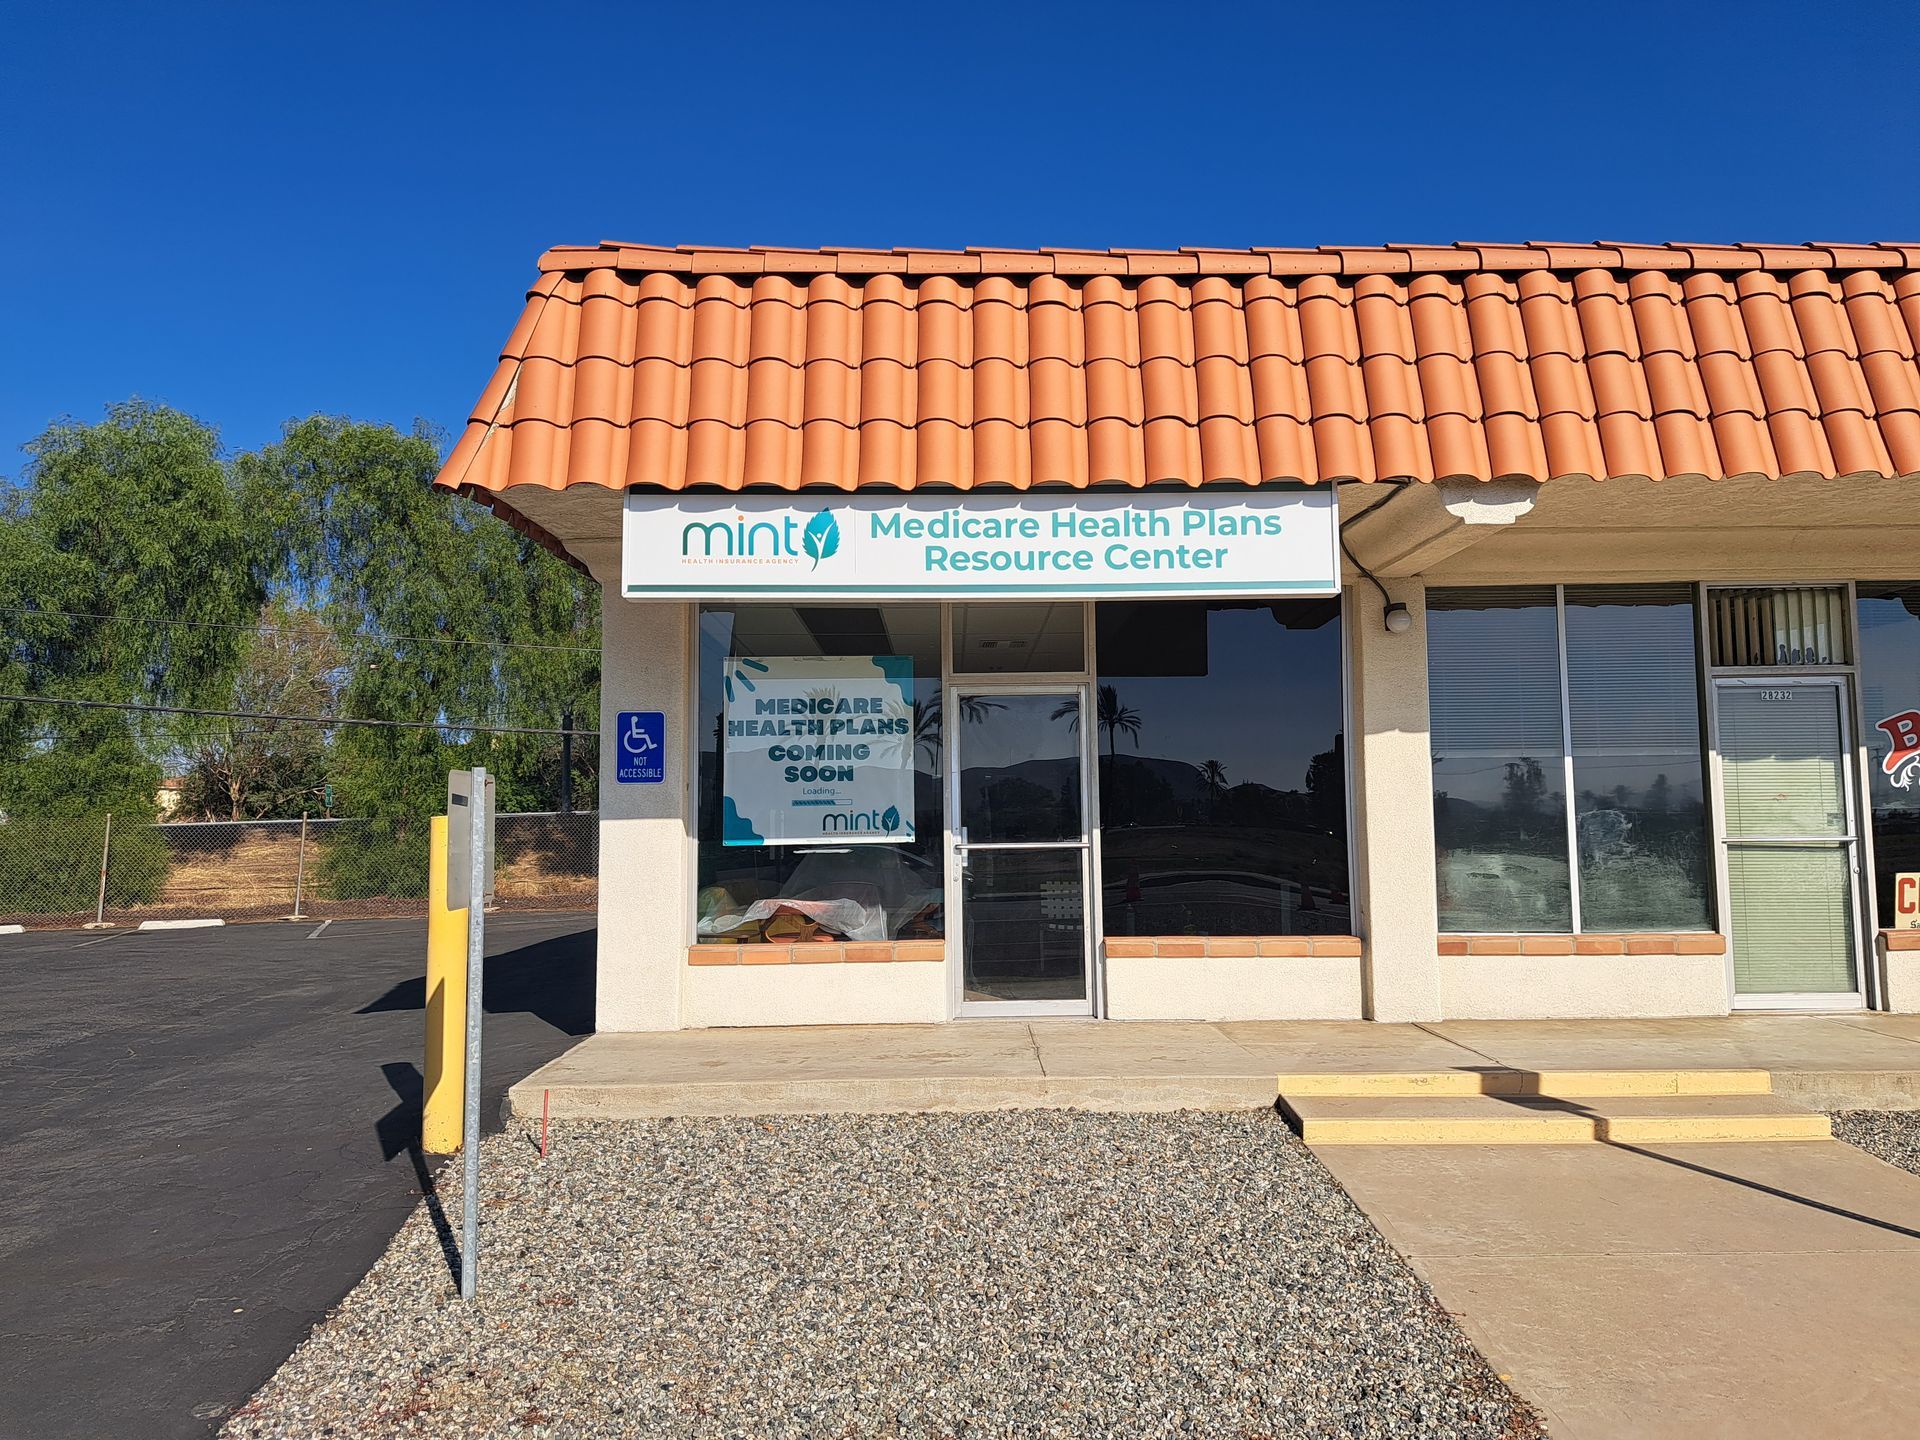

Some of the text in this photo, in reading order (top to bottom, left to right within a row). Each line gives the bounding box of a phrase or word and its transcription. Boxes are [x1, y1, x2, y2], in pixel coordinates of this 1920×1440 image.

[871, 508, 1282, 539] Medicare Health Plans
[682, 515, 798, 556] mint
[925, 543, 1228, 571] Resource Center
[1762, 691, 1792, 700] 28232
[755, 697, 883, 715] MEDICARE
[728, 718, 910, 737] HEALTH PLANS
[633, 757, 647, 766] NOT
[768, 744, 871, 762] COMING
[619, 768, 662, 778] ACCESSIBLE
[784, 765, 854, 783] SOON
[822, 810, 880, 831] mint
